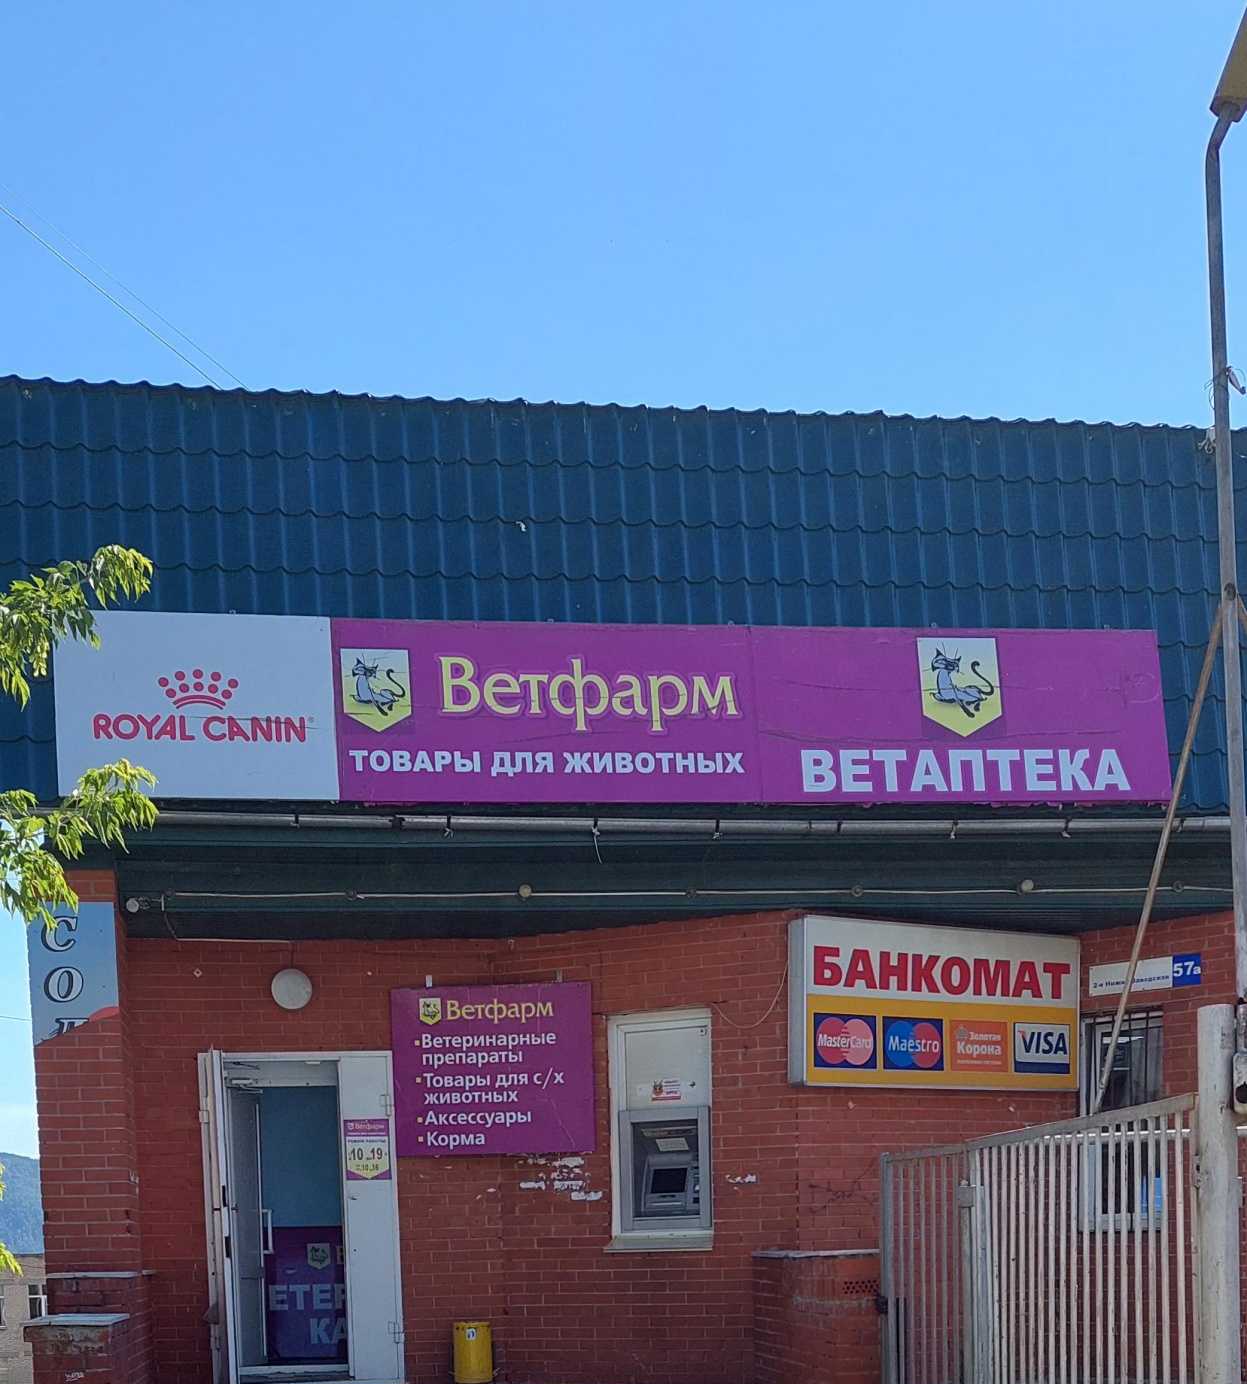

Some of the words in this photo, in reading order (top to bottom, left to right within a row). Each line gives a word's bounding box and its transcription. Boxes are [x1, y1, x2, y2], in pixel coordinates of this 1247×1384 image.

[437, 654, 739, 733] Ветфарм
[93, 713, 195, 741] ROYAL
[203, 715, 306, 743] CANIN
[349, 749, 480, 773] ТОВАРЫ
[490, 750, 554, 776] ДЛЯ
[563, 751, 744, 774] ЖИВОТНЫХ
[801, 748, 1131, 793] ВЕТАПТЕКА
[813, 945, 1071, 999] БАНКОМАТ
[447, 999, 554, 1024] Ветфарм
[422, 1032, 557, 1050] Ветеринарные
[817, 1033, 872, 1049] MasterCard
[888, 1035, 940, 1053] Maestro
[957, 1041, 1002, 1058] Корона
[1017, 1030, 1068, 1055] VISA
[422, 1051, 523, 1069] препараты
[424, 1072, 490, 1090] Товары
[495, 1072, 528, 1087] для
[533, 1068, 564, 1089] с/х
[424, 1090, 518, 1105] животных
[425, 1110, 532, 1127] Аксессуары
[427, 1131, 486, 1149] Корма
[351, 1147, 364, 1161] 10
